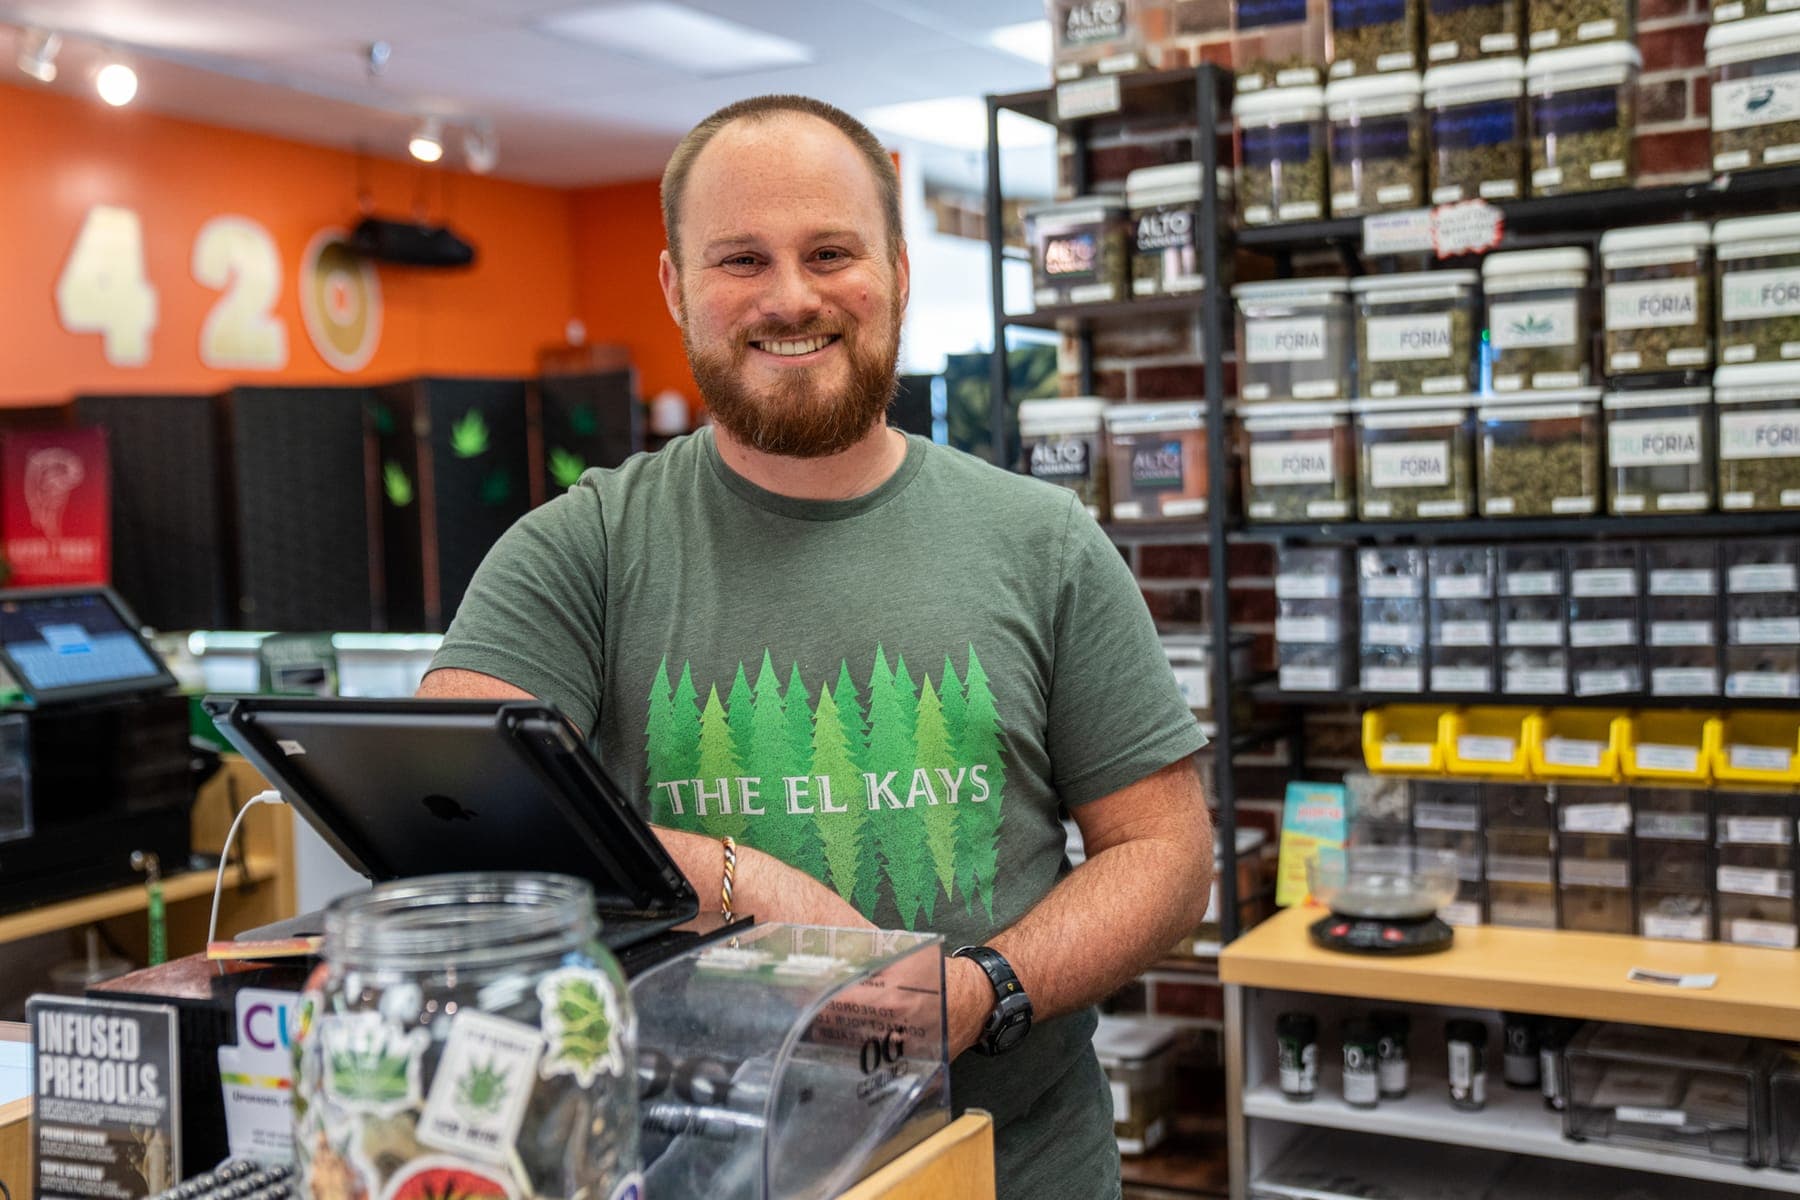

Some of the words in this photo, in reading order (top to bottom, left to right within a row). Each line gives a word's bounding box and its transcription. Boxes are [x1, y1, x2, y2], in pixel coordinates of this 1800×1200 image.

[1138, 210, 1191, 237] ALTO
[1031, 440, 1085, 464] ALTO
[1133, 452, 1179, 470] ALTO
[657, 777, 765, 816] THE
[783, 774, 848, 815] EL
[863, 764, 990, 811] KAYS
[38, 1010, 140, 1062] INFUSED
[39, 1055, 160, 1104] PREROLLS
